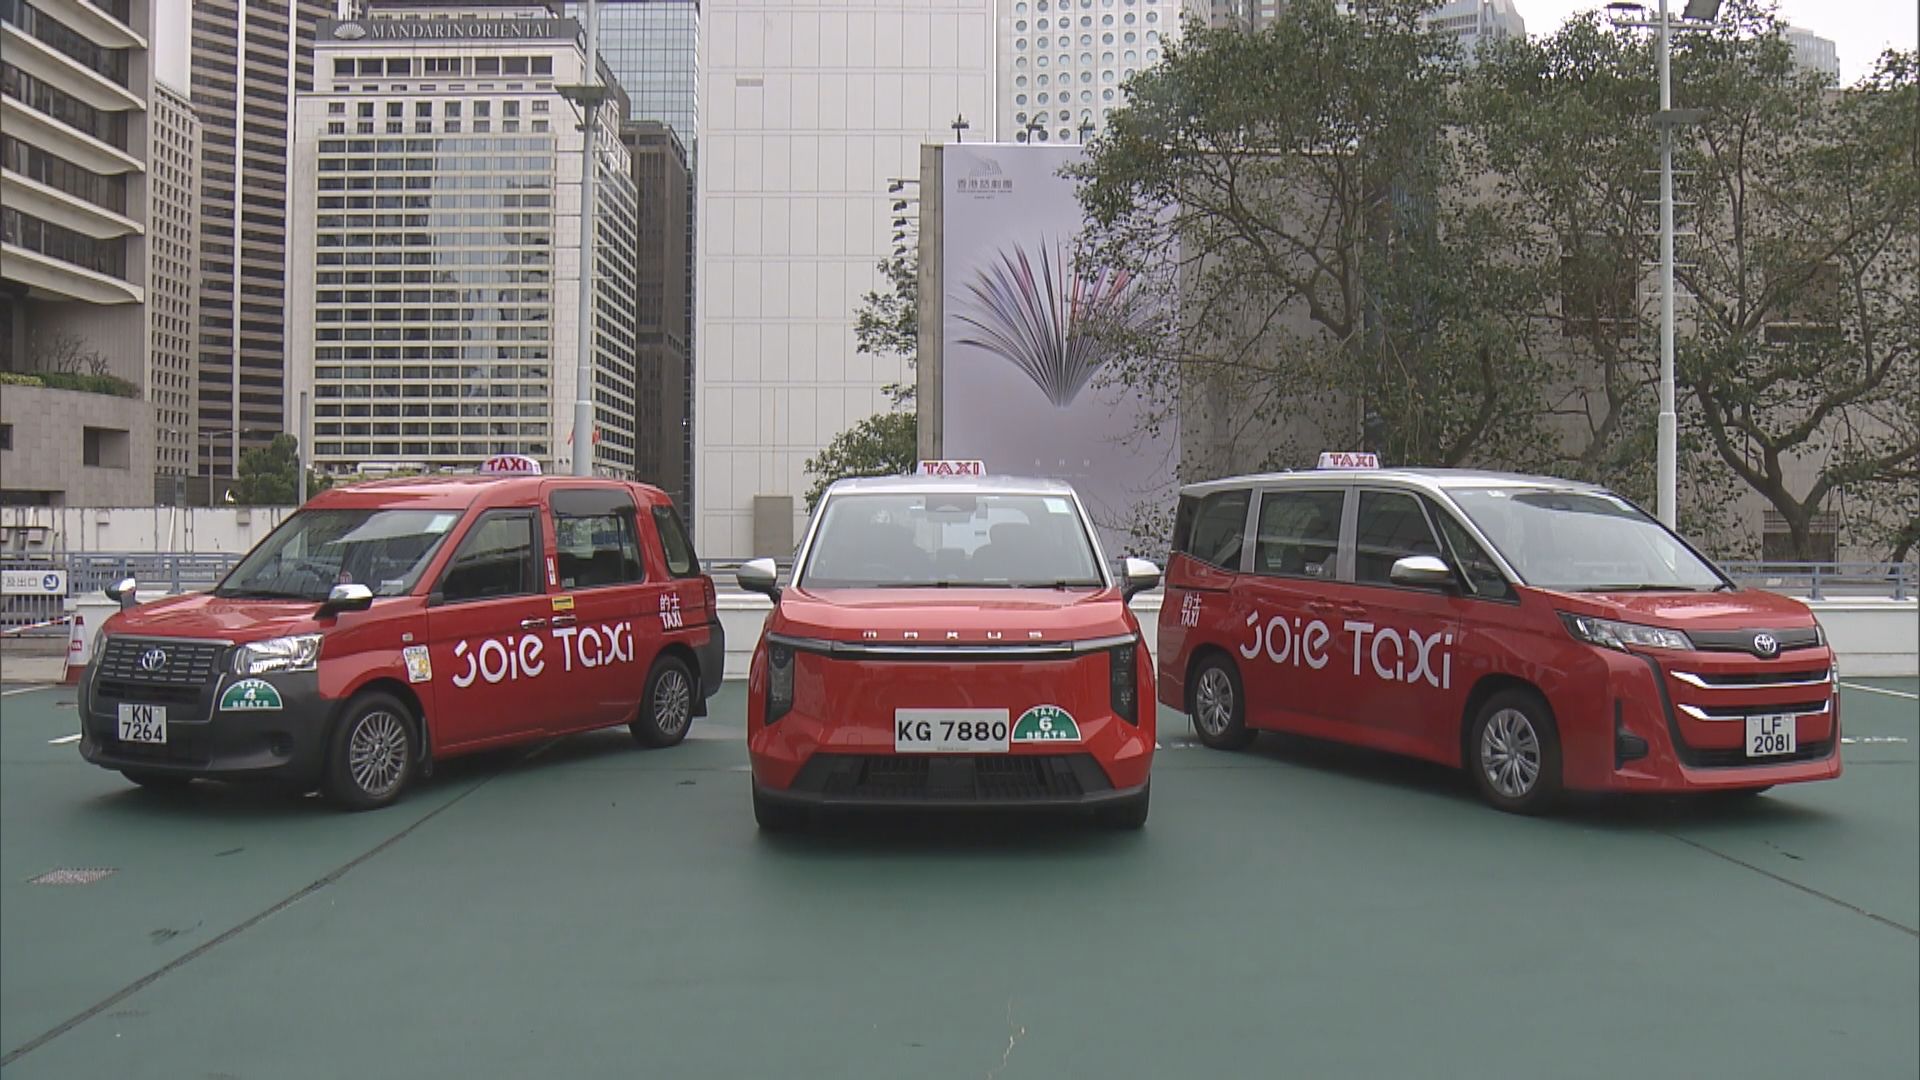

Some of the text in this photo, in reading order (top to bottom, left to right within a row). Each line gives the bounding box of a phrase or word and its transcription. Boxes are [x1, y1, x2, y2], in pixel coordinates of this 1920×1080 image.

[371, 22, 554, 39] MANDARIN ORIENTAL
[487, 457, 527, 471] TAXI
[922, 461, 980, 476] TAXI
[1330, 453, 1374, 467] TAXI
[659, 592, 681, 611] 的士
[1183, 592, 1202, 609] 的士
[659, 611, 683, 630] TAXI
[1180, 609, 1199, 627] TAXI
[244, 688, 257, 700] 4
[132, 705, 152, 723] KN
[1033, 707, 1060, 718] TAXI
[122, 721, 163, 742] 7264
[898, 720, 1007, 742] KG 7880
[1039, 717, 1053, 731] 6
[1761, 716, 1782, 735] LF
[1026, 731, 1067, 739] SEATS
[1753, 733, 1790, 753] 2081
